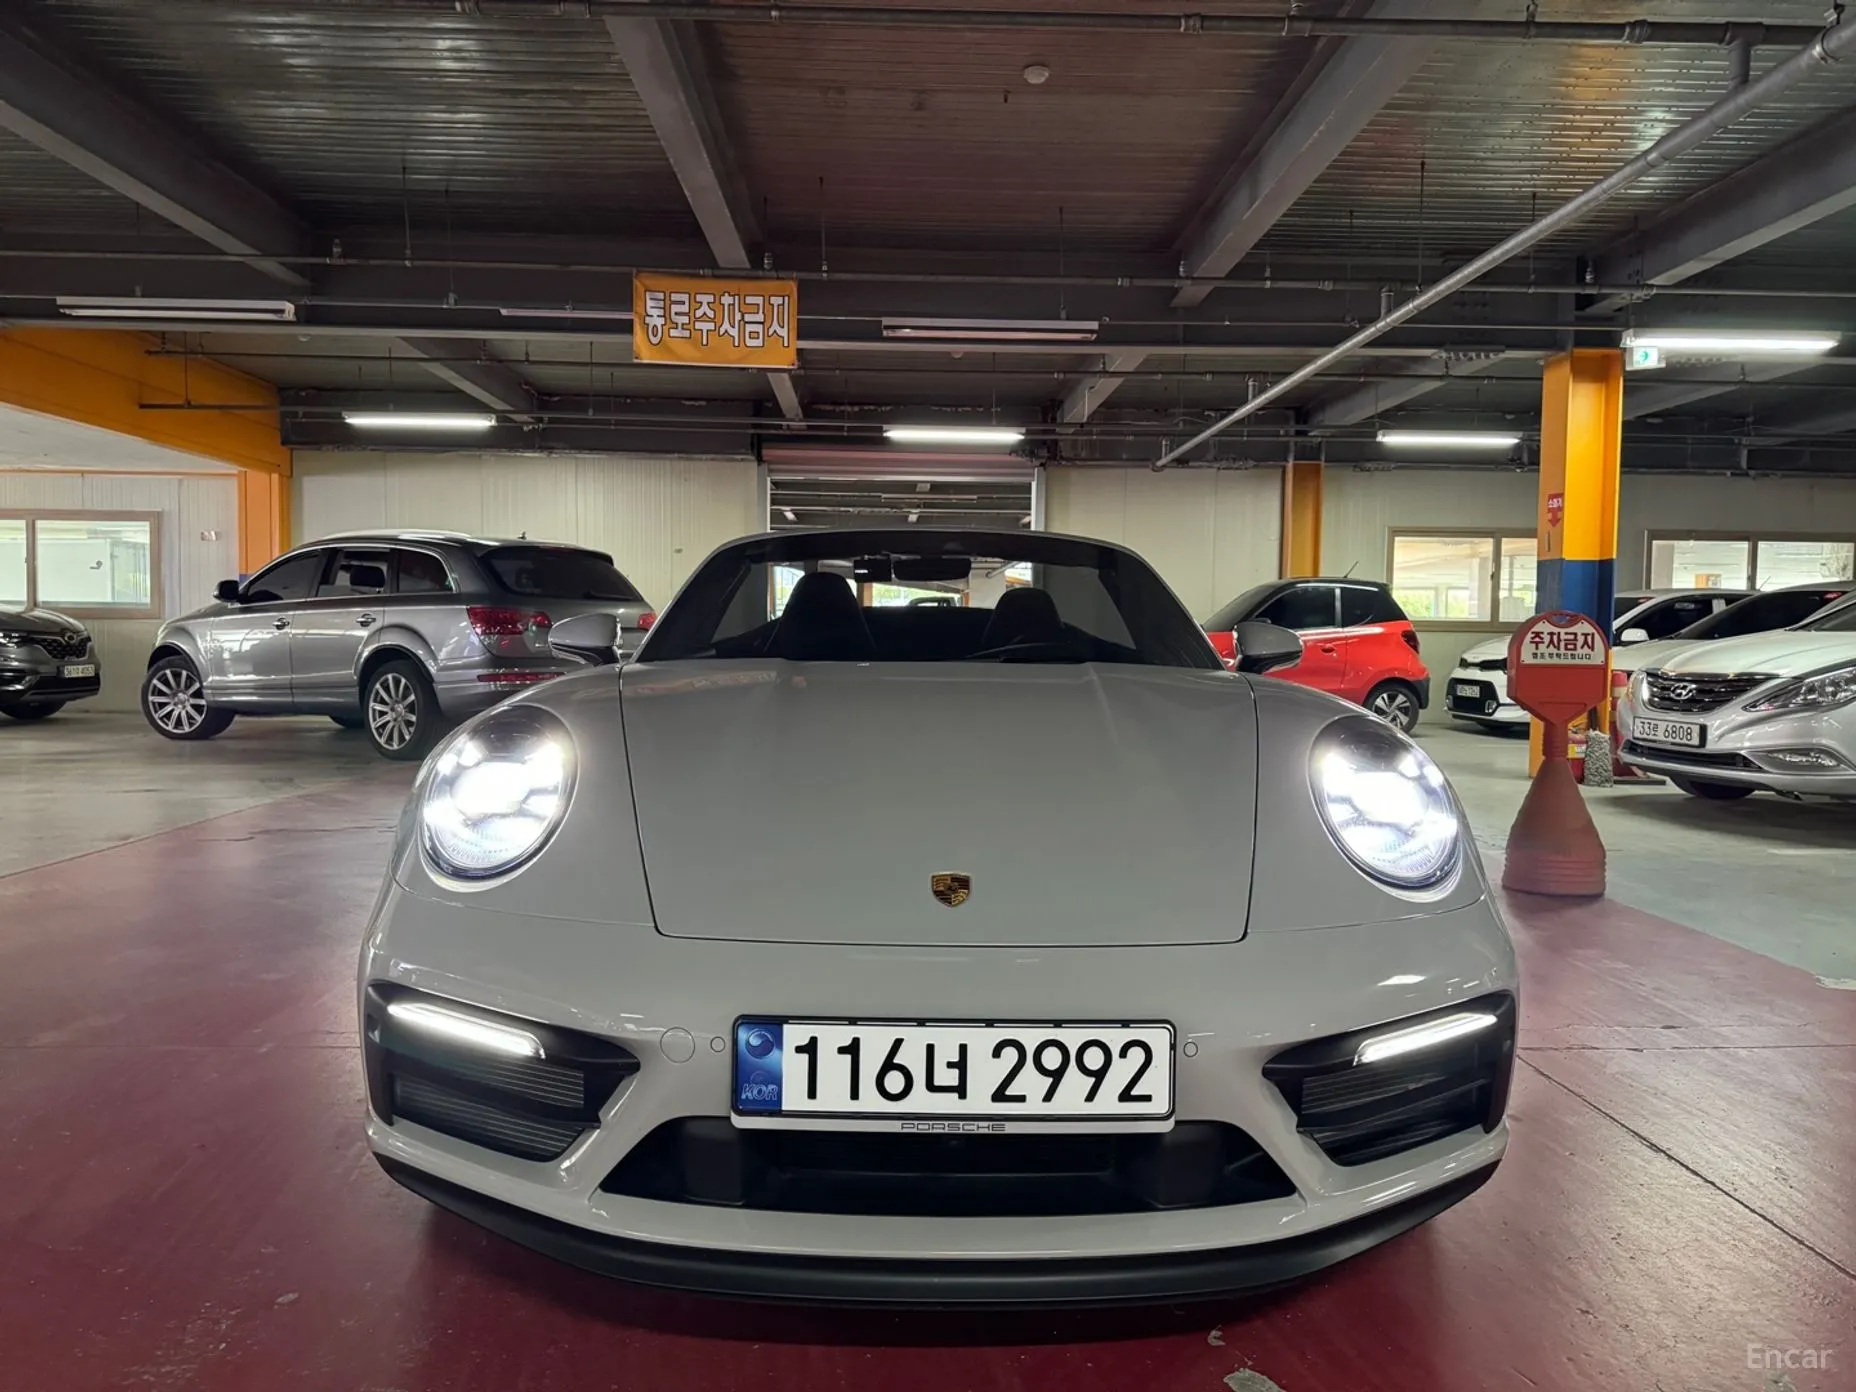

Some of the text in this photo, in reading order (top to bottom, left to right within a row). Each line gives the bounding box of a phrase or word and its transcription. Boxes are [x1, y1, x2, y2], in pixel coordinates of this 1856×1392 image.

[644, 290, 790, 348] 통로주차금지
[1529, 631, 1595, 652] 주차금지
[1663, 724, 1693, 741] 6808
[794, 1035, 1154, 1103] 116너 2992
[741, 1083, 778, 1101] KOR
[901, 1122, 1006, 1132] PORSCHE
